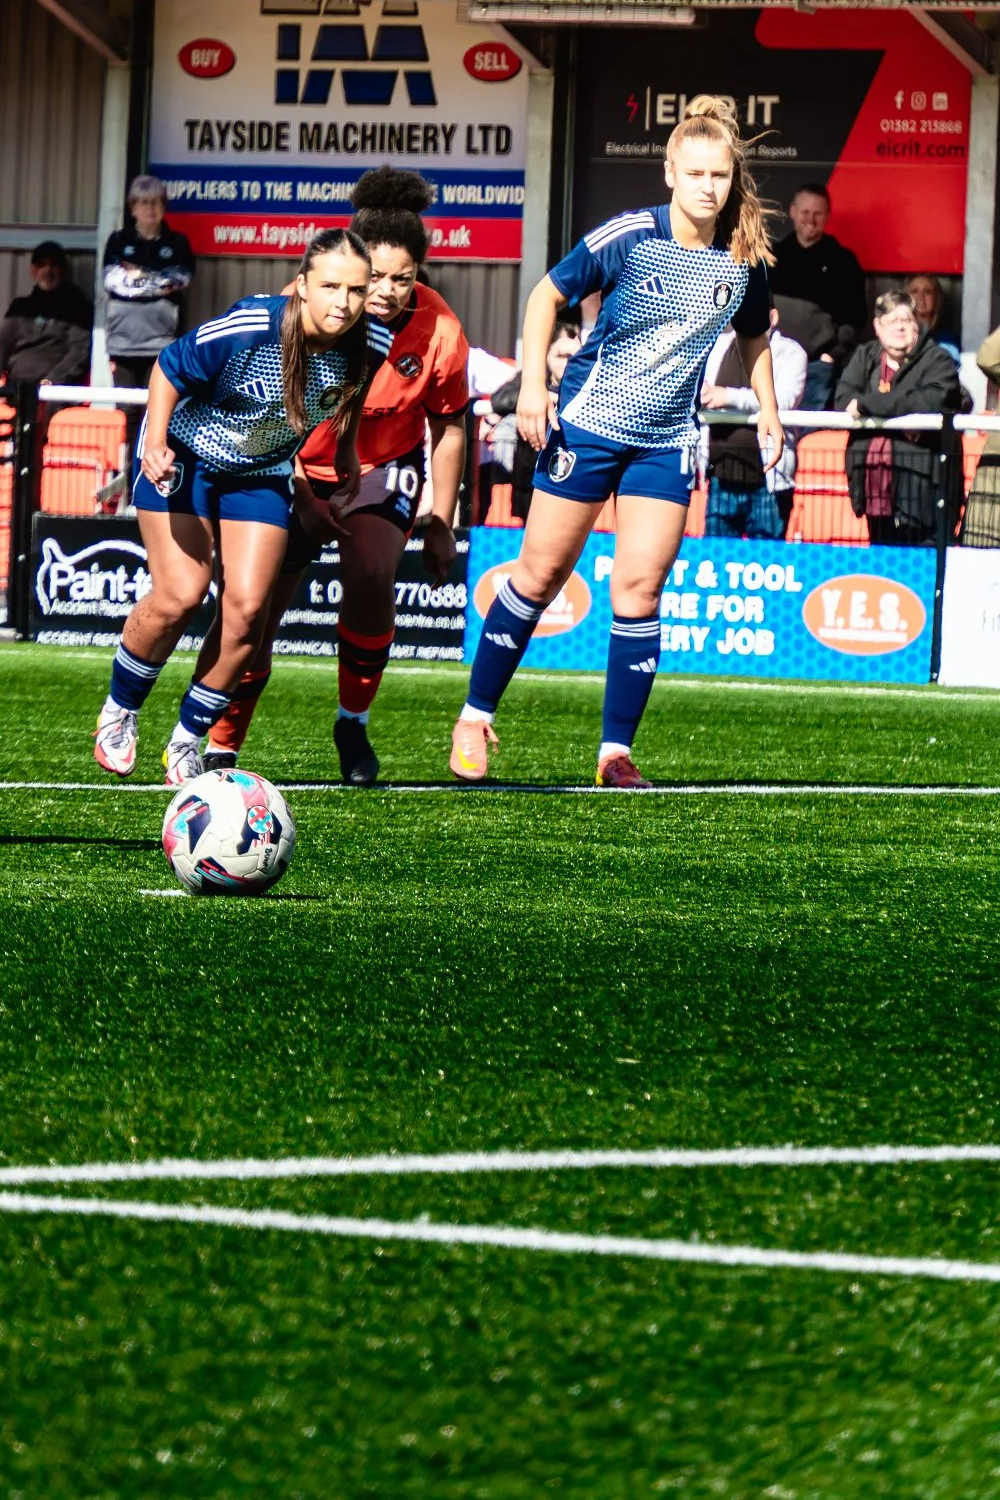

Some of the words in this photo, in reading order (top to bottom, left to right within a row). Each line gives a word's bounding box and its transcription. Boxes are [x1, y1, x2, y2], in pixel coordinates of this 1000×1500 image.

[190, 48, 222, 68] BUY
[474, 50, 510, 71] SELL
[746, 95, 780, 127] IT
[185, 119, 290, 152] TAYSIDE
[299, 121, 458, 155] MACHINERY
[465, 124, 512, 155] LTD
[606, 141, 650, 157] Electrical
[758, 144, 797, 158] Reports
[876, 138, 966, 158] eicrit.com
[241, 181, 262, 201] TO
[265, 182, 292, 201] THE
[296, 181, 358, 203] MACHIN
[443, 184, 526, 205] WORLDWID
[385, 461, 418, 500] 10
[695, 560, 718, 588] &
[725, 561, 802, 593] TOOL
[705, 594, 764, 624] FOR
[272, 638, 335, 656] ECHANICAL
[660, 624, 711, 653] ERY
[716, 627, 776, 656] JOB
